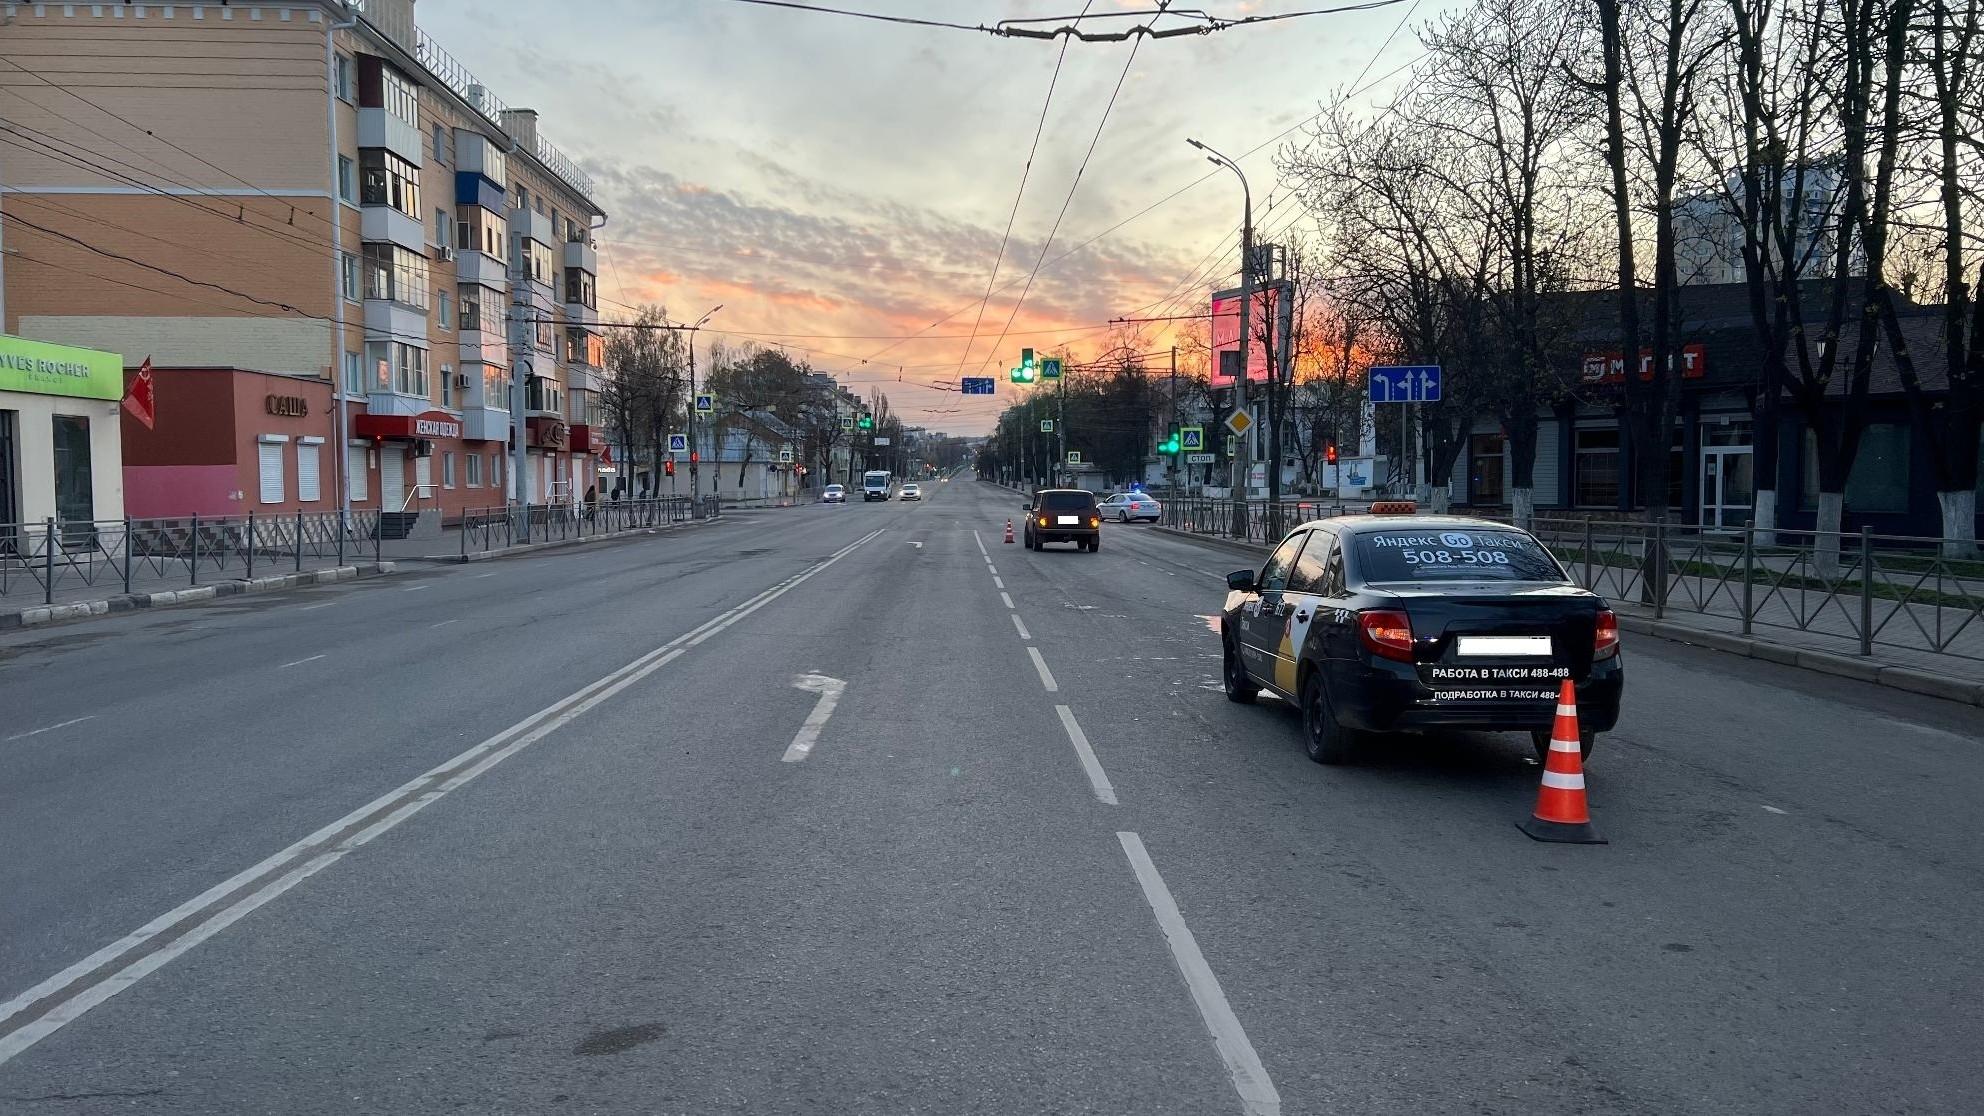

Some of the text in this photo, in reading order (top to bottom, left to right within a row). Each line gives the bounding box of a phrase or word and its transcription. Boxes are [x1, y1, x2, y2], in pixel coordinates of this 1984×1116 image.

[0, 353, 90, 378] YVES ROCHER
[415, 419, 460, 438] ЖЕНСКАЯ ОДЕЖДА
[1373, 534, 1523, 549] Яндекс Go Такси
[1402, 550, 1509, 564] 508-508
[1432, 667, 1570, 679] РАБОТА В ТАКСИ 488-488
[1434, 690, 1560, 701] ПОДРАБОТКА В ТАКСИ 488-
